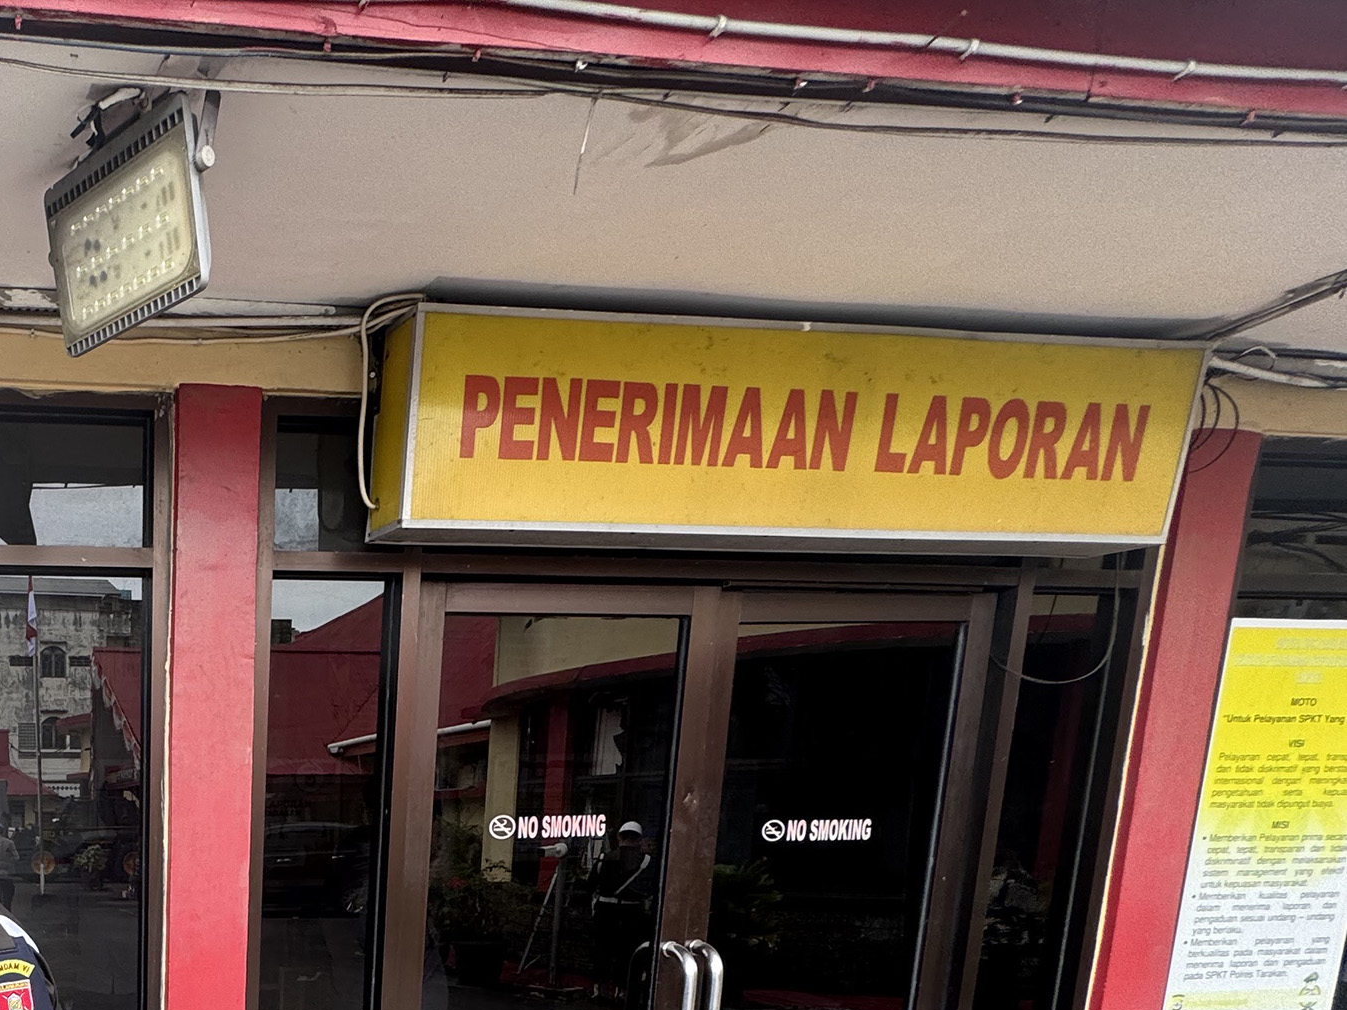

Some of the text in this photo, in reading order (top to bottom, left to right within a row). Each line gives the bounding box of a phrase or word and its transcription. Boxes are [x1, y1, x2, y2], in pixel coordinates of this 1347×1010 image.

[459, 374, 1151, 482] PENERIMAAN LAPORAN
[1291, 698, 1317, 706] MOTO
[1254, 715, 1296, 725] Pelayanan
[1325, 715, 1345, 725] Yang
[1288, 739, 1305, 747] VISI
[517, 814, 606, 839] NO SMOKING
[1272, 821, 1290, 829] MISI
[786, 819, 872, 841] NO SMOKING
[23, 965, 30, 973] VI
